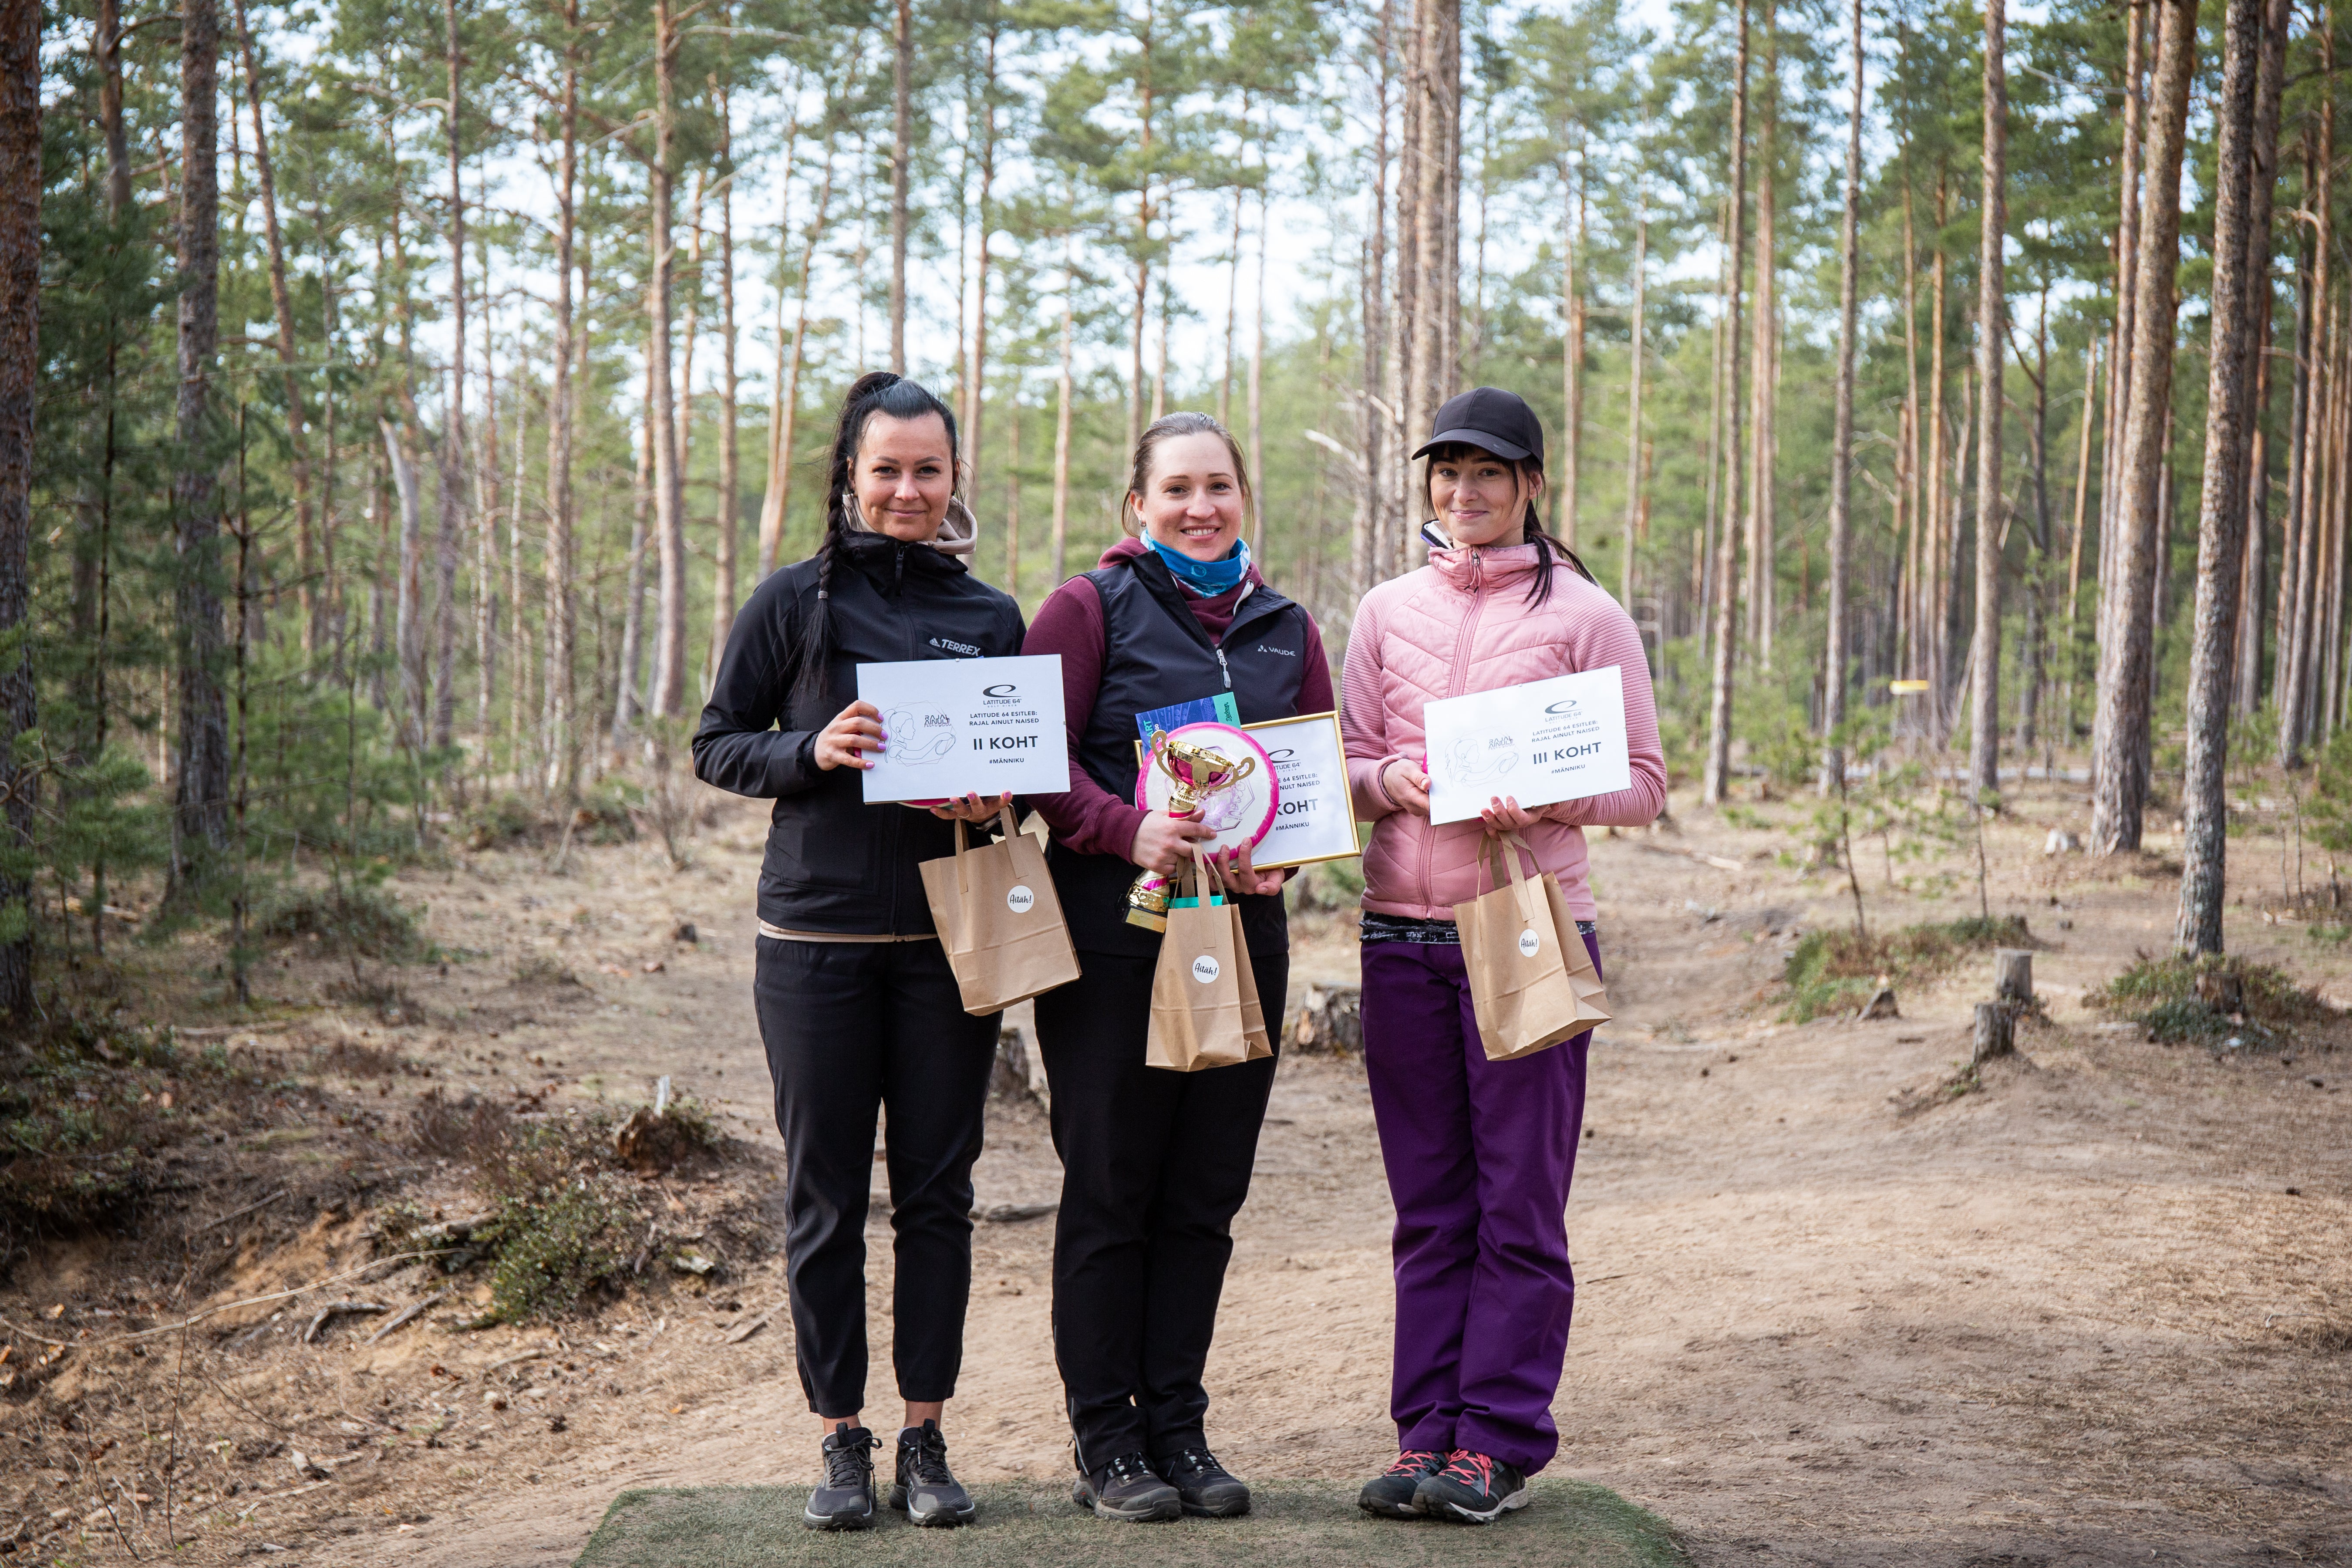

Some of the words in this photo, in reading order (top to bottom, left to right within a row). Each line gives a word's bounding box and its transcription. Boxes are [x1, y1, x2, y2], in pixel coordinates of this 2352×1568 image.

[941, 639, 981, 657] TERREX
[1268, 647, 1296, 656] VAUDE
[1545, 713, 1572, 722] LATITUDE
[1533, 727, 1561, 736] LATITUDE
[1553, 731, 1574, 739] AINULT
[974, 738, 982, 750] II
[990, 736, 1038, 749] KOHT
[1533, 752, 1547, 764] III
[1554, 742, 1601, 760] KOHT
[1551, 764, 1585, 774] #MÄNNIKU
[1276, 822, 1309, 831] #MÄNNIKU
[1010, 894, 1031, 904] Aitäh!
[1521, 938, 1537, 948] Aitäh!
[1195, 963, 1217, 975] Aitäh!
